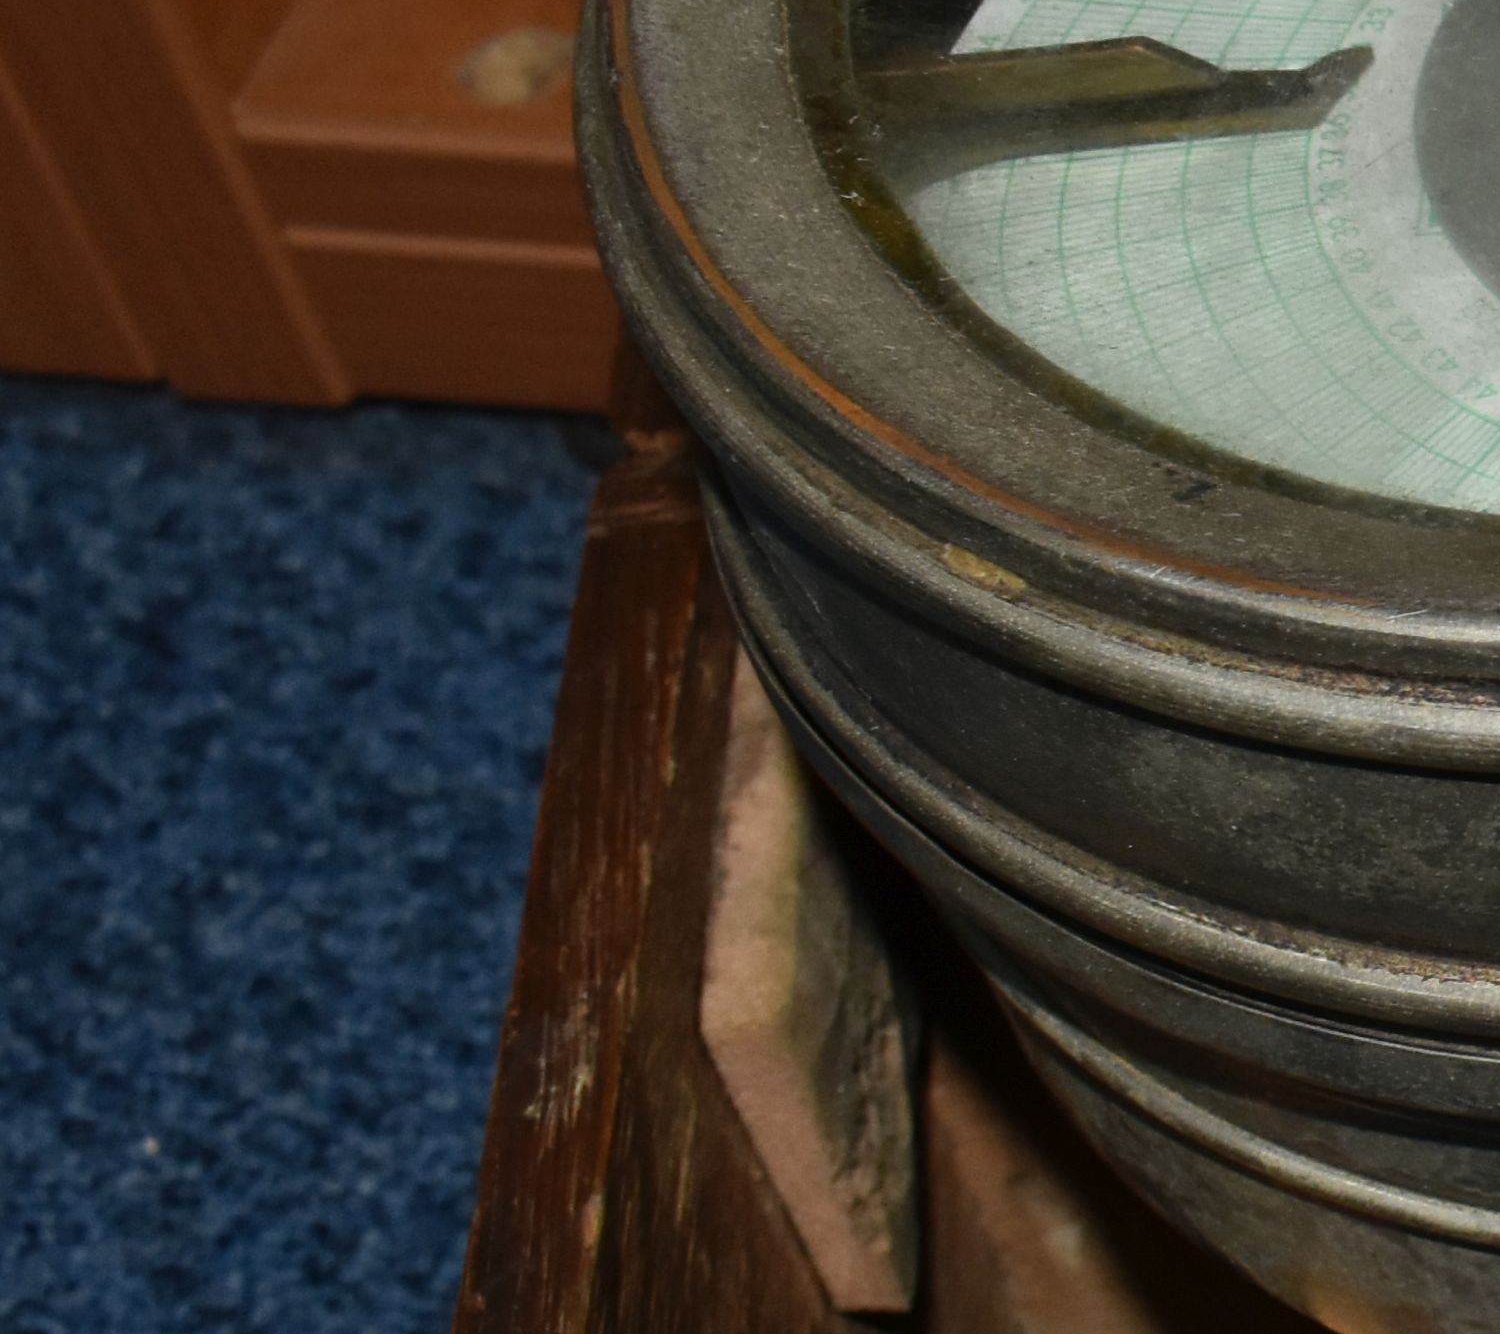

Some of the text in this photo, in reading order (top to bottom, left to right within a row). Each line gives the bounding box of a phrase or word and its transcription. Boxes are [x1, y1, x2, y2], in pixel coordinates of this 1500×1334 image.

[1359, 7, 1394, 31] 33
[1317, 148, 1347, 169] 37
[1318, 179, 1348, 205] 38
[1327, 214, 1360, 241] 39
[1340, 247, 1374, 273] 40
[1387, 315, 1423, 342] 42
[1421, 346, 1459, 372] 43
[1458, 373, 1498, 399] 44
